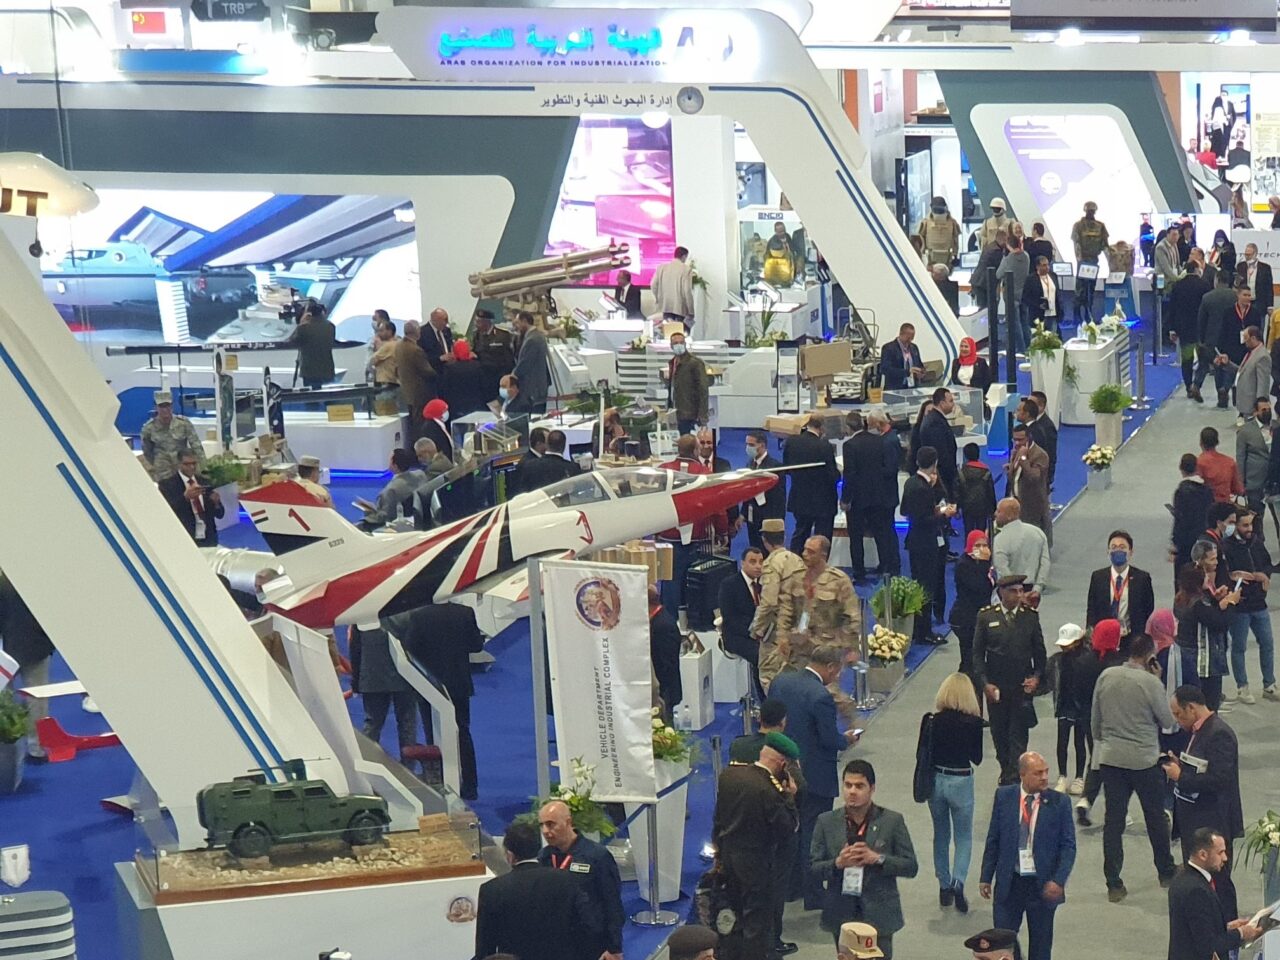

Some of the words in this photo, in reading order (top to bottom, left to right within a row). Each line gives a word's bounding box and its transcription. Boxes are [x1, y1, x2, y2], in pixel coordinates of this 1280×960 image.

[583, 92, 609, 108] الفنية
[612, 93, 647, 108] البحوث
[649, 94, 673, 108] إدارة
[602, 637, 611, 679] COMPLEX
[593, 666, 606, 722] DEPARTMENT
[604, 681, 614, 732] INDUSTRIAL
[599, 721, 608, 760] VEHICLE
[609, 732, 623, 788] ENGINEERING
